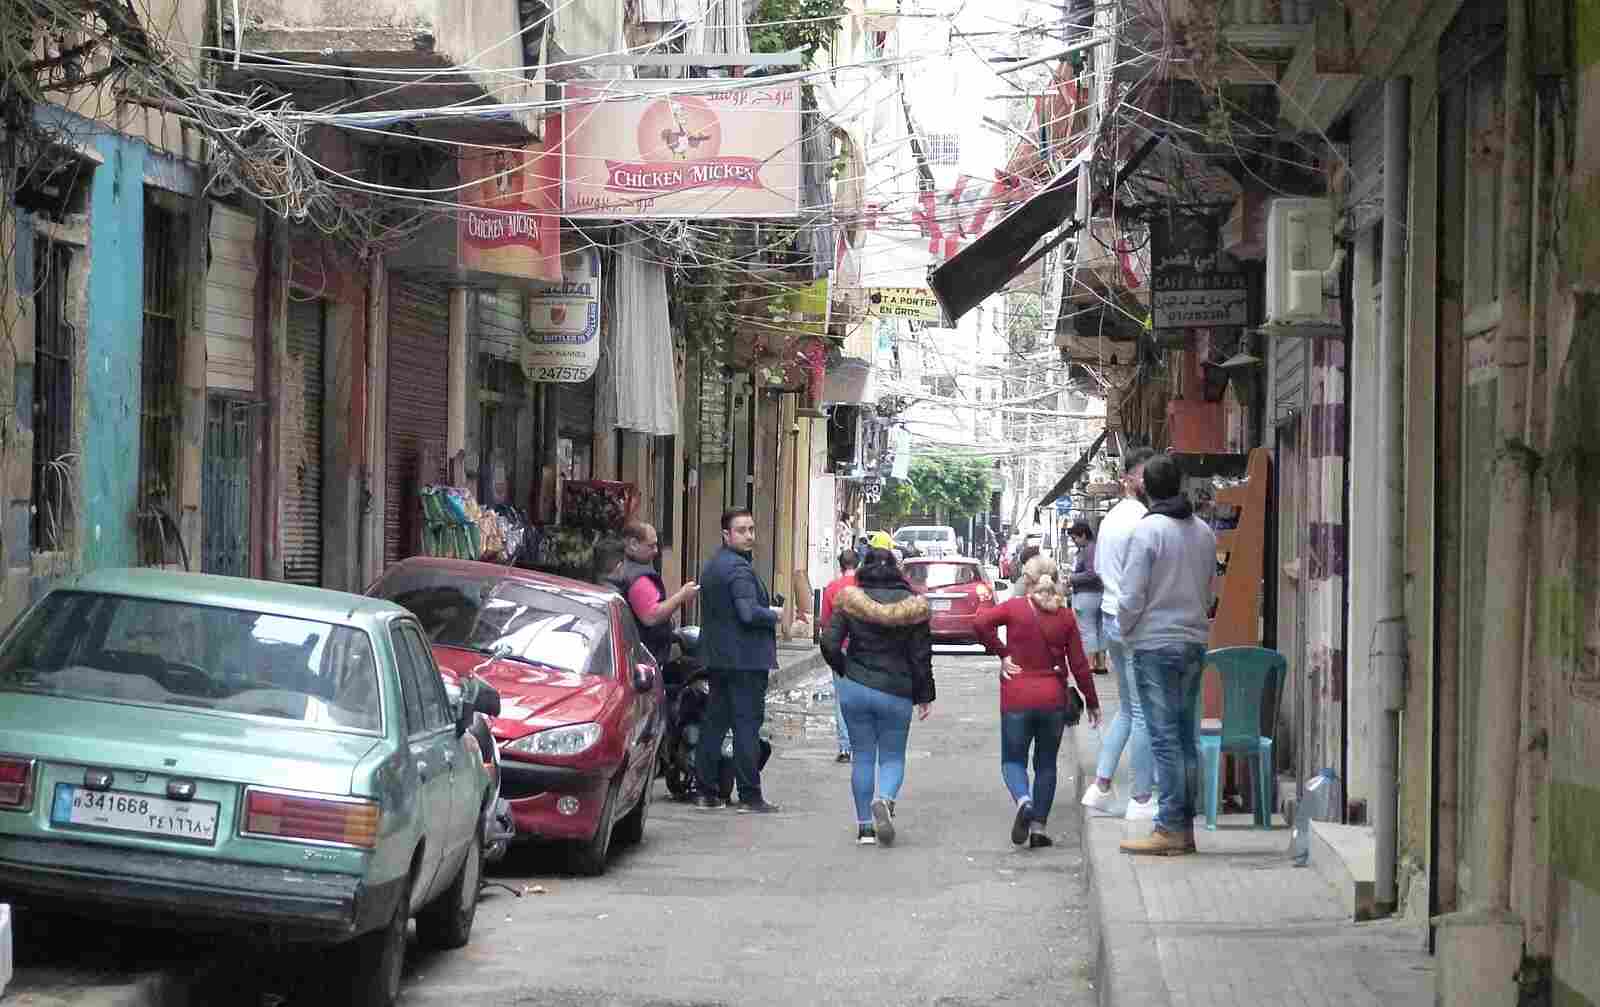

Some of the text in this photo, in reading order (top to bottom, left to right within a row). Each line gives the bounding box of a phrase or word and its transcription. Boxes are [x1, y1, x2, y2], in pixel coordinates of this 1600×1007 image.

[614, 163, 754, 188] CHICKEN MICKEN
[468, 212, 539, 241] CHICKEN MICKEN
[538, 367, 588, 381] 247575
[84, 793, 149, 815] 341668
